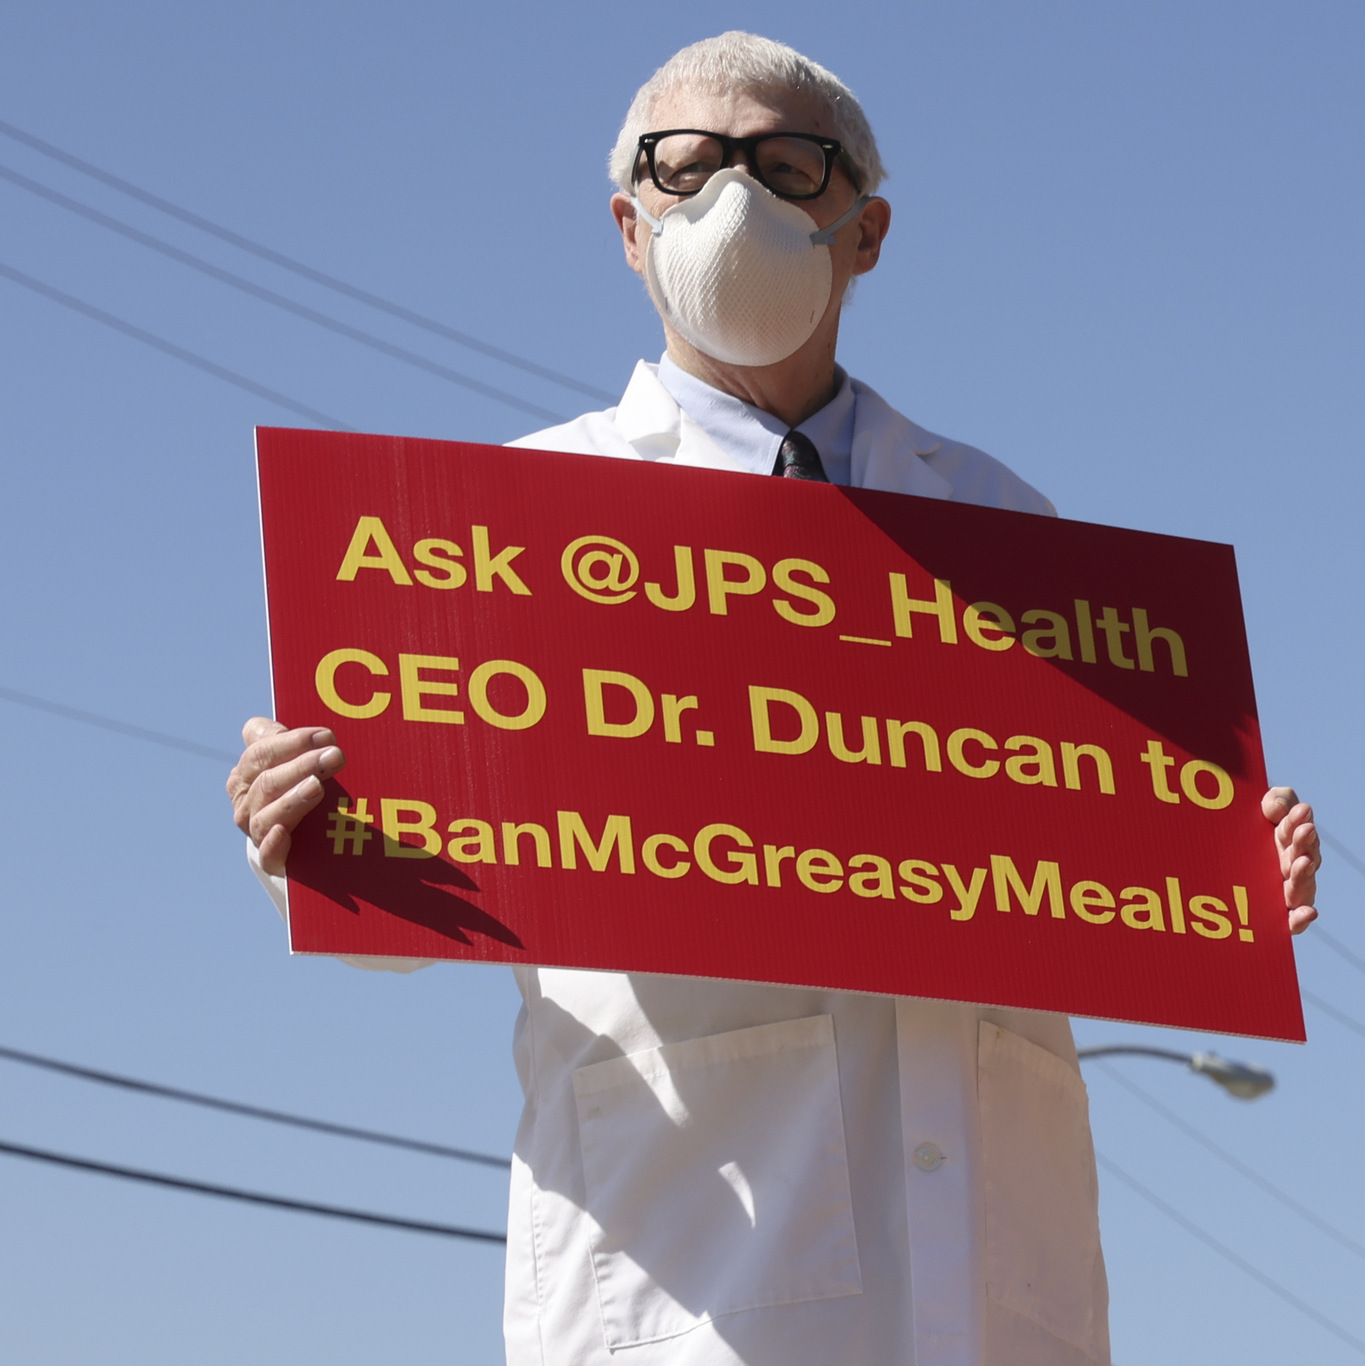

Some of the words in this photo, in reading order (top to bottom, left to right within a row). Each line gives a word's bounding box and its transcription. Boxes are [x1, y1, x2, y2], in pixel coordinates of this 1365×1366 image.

[338, 516, 532, 595] Ask
[561, 536, 1188, 676] @JPS_Health
[316, 648, 547, 730] CEO
[583, 669, 715, 746] Dr.
[749, 686, 1116, 794] Duncan
[1141, 740, 1234, 809] to
[328, 798, 1254, 942] #BanMcGreasyMeals!
